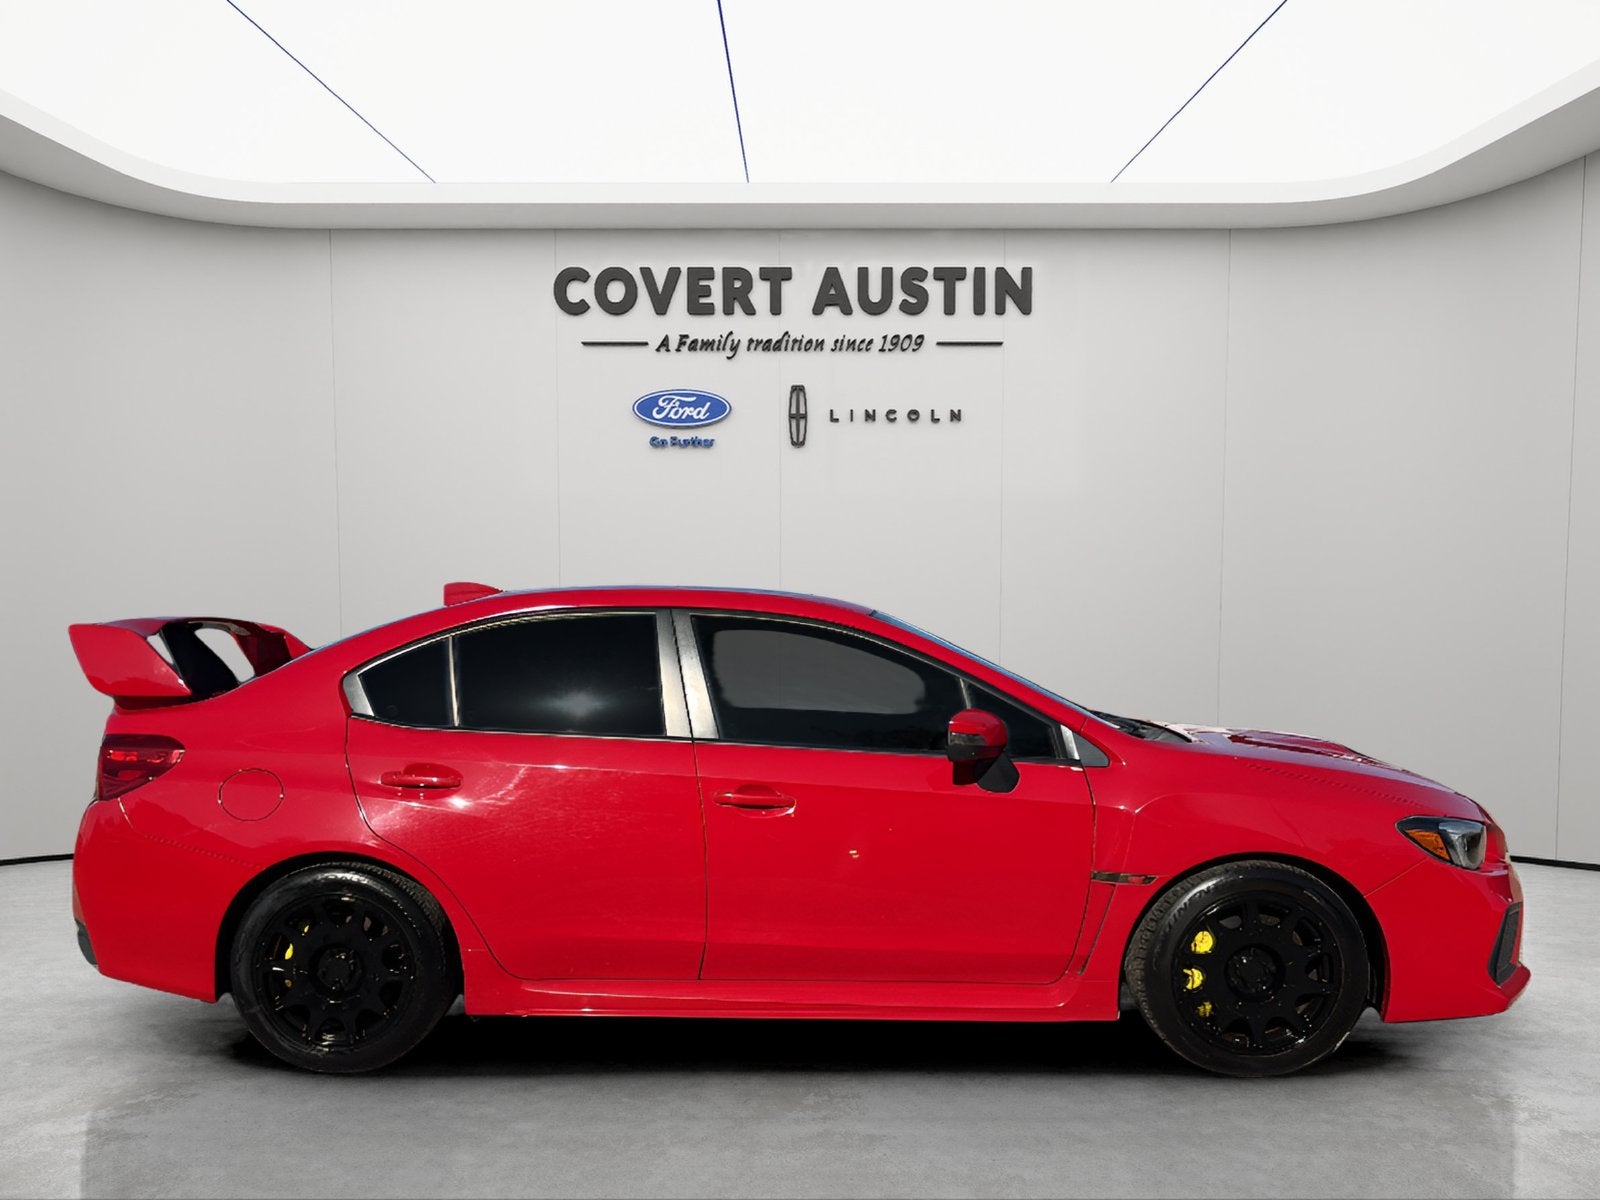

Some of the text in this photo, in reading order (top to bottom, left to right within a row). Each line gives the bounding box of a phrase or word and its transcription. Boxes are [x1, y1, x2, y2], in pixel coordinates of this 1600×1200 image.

[554, 266, 1033, 316] COVERT AUSTIN
[656, 330, 925, 360] A Family tradition since 1909
[652, 395, 711, 419] Ford
[829, 409, 962, 423] LINCOLN
[649, 436, 668, 448] Go
